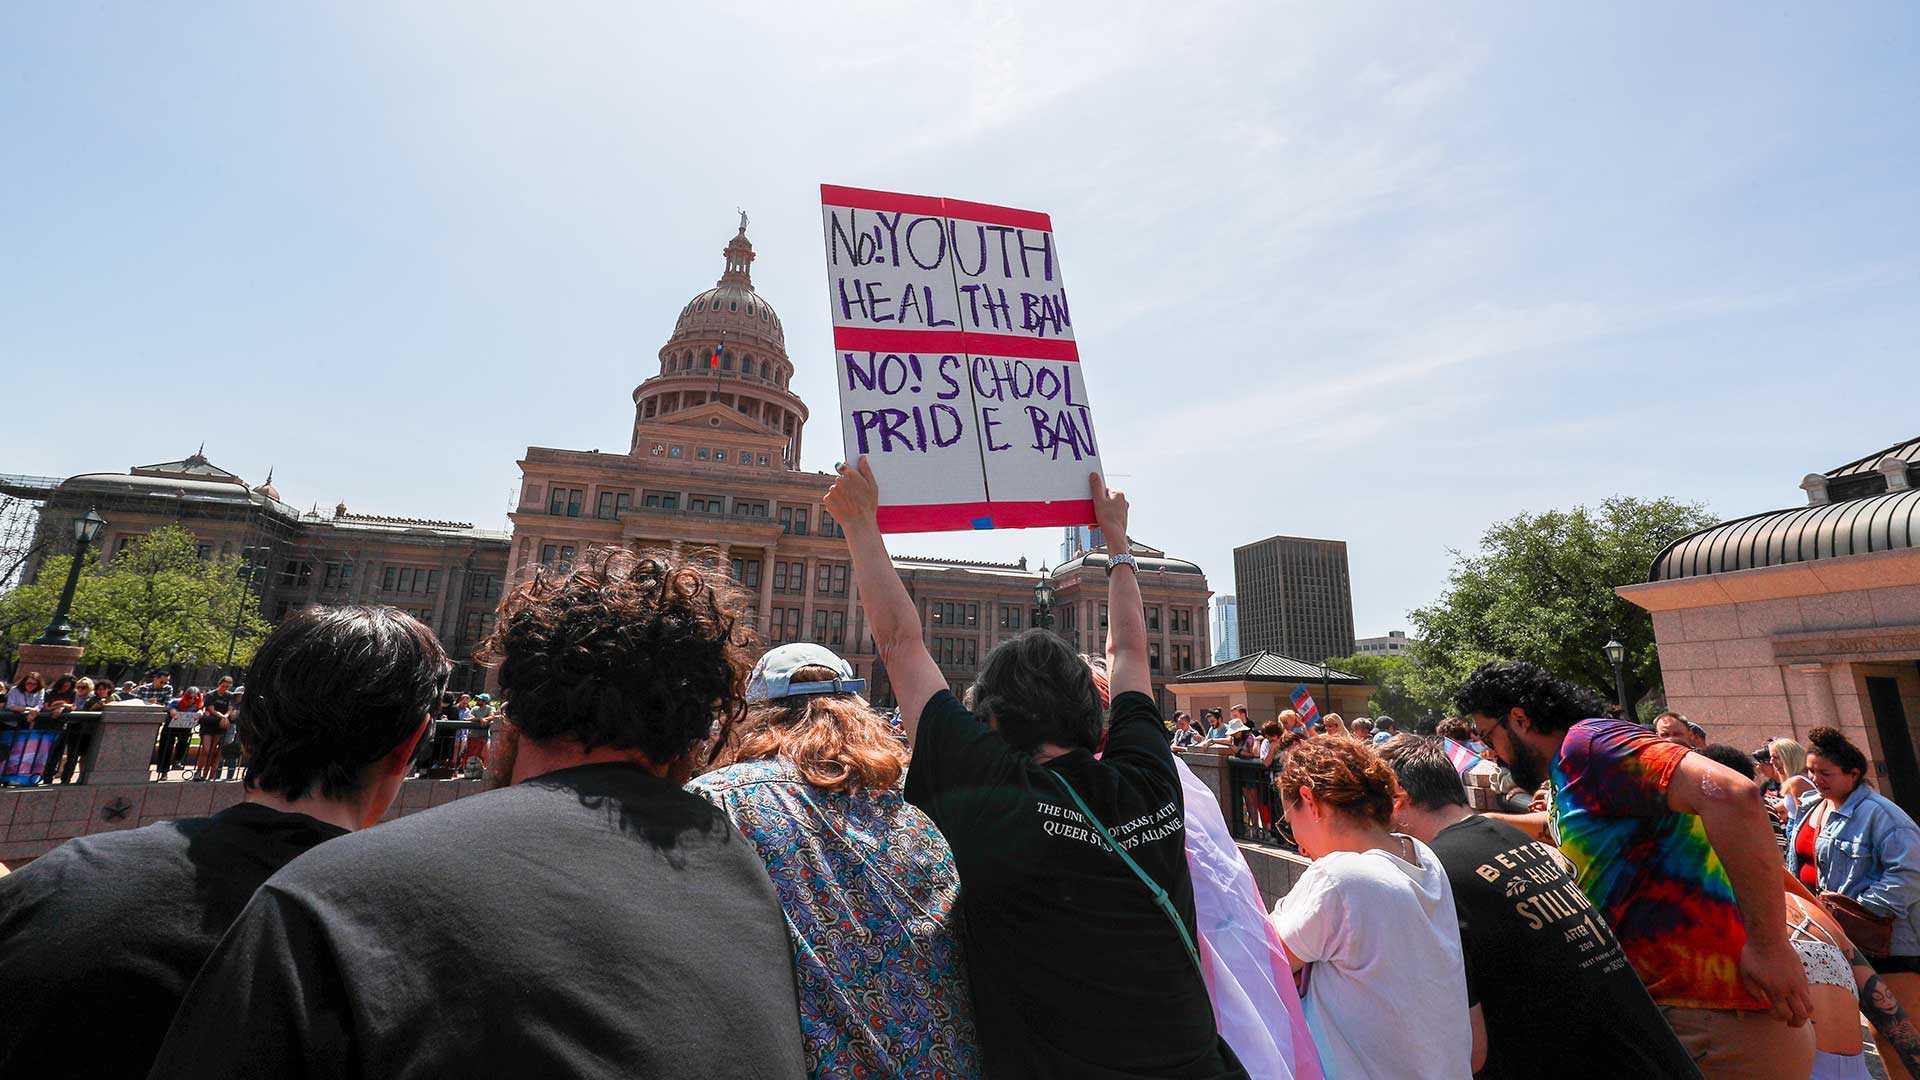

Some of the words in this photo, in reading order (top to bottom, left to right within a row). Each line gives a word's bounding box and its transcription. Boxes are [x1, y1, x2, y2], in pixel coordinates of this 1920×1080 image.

[876, 212, 1053, 281] YOUTH
[1020, 288, 1071, 337] BAN
[844, 352, 923, 395] NO!
[1024, 406, 1096, 460] BAN
[1037, 802, 1061, 818] THE
[1043, 820, 1088, 841] QUEER
[1475, 841, 1548, 883] BETTE
[1515, 889, 1577, 930] STILL
[1563, 924, 1589, 943] AFTER
